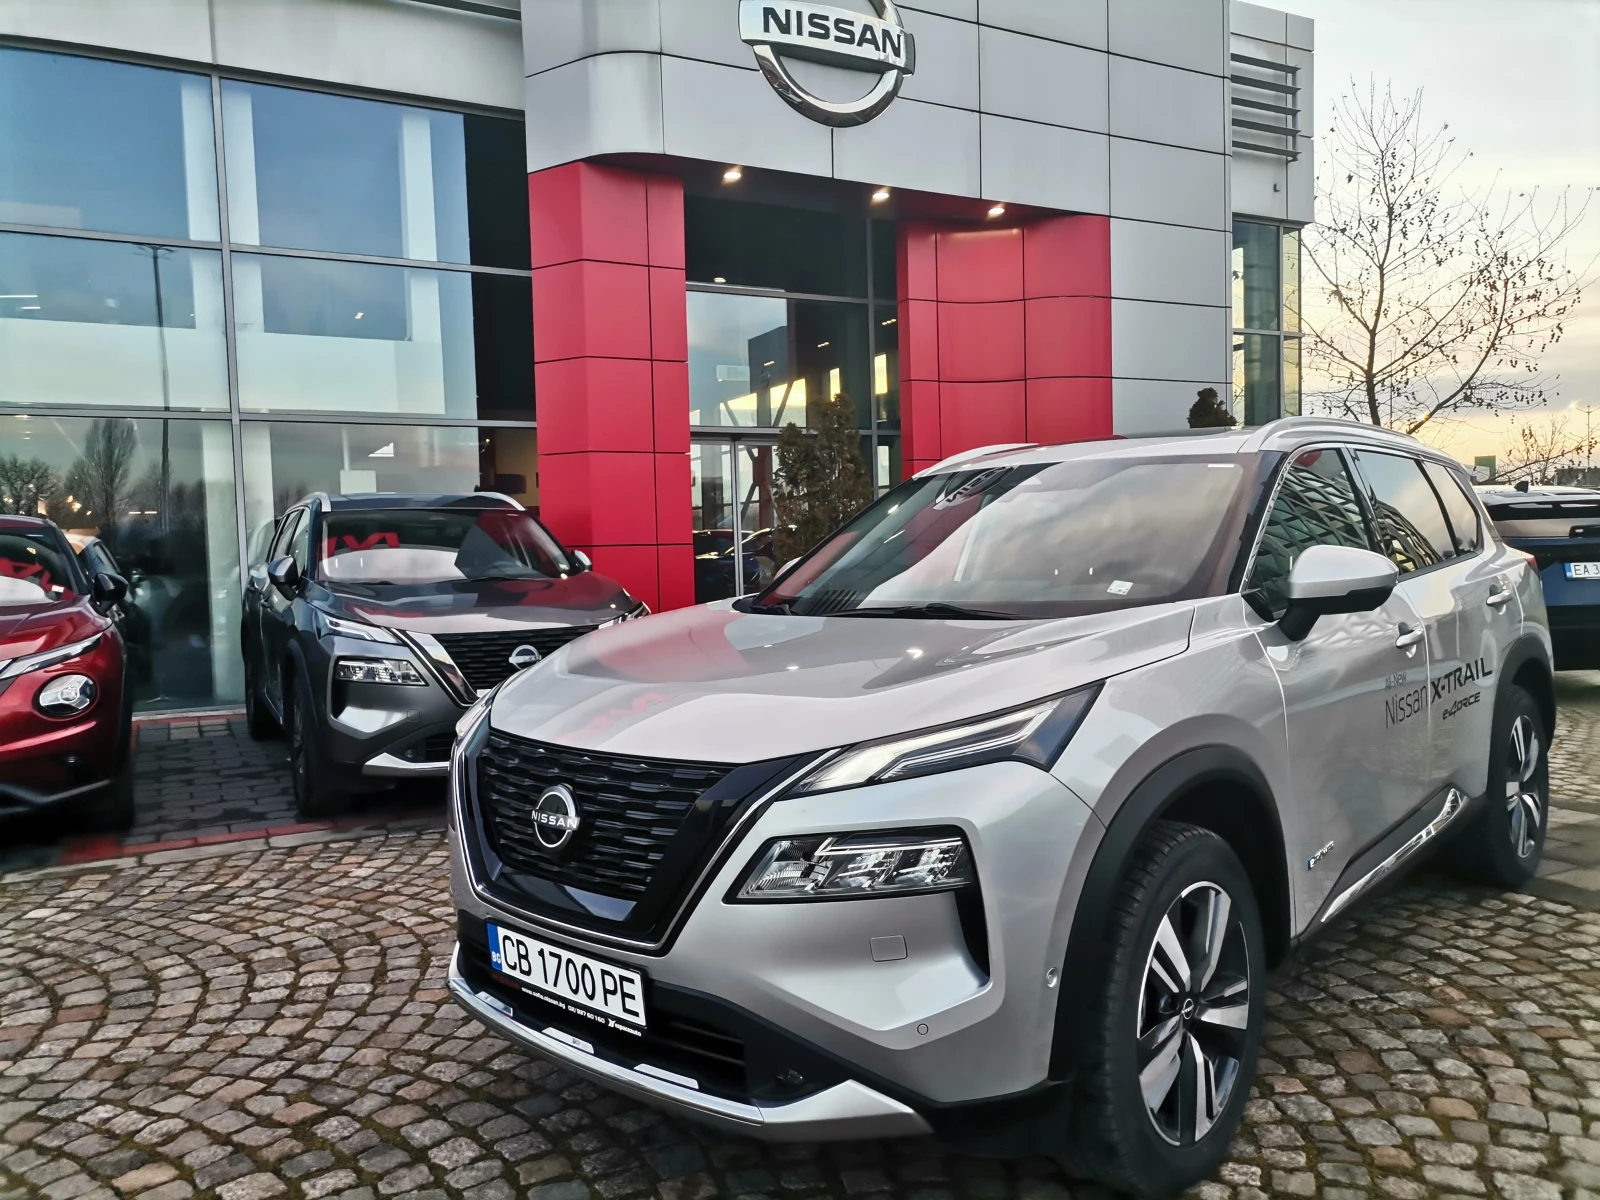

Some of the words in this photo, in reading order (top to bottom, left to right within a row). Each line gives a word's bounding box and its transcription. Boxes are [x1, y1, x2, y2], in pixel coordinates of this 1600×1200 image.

[762, 6, 902, 58] NISSAN
[1573, 564, 1590, 576] EA
[1385, 685, 1428, 729] Nissan
[1431, 657, 1493, 704] X-TRAIL
[531, 810, 578, 829] NISSAN
[491, 950, 502, 963] BG
[502, 934, 532, 976] CB
[537, 947, 596, 1001] 1700
[600, 968, 640, 1018] PE
